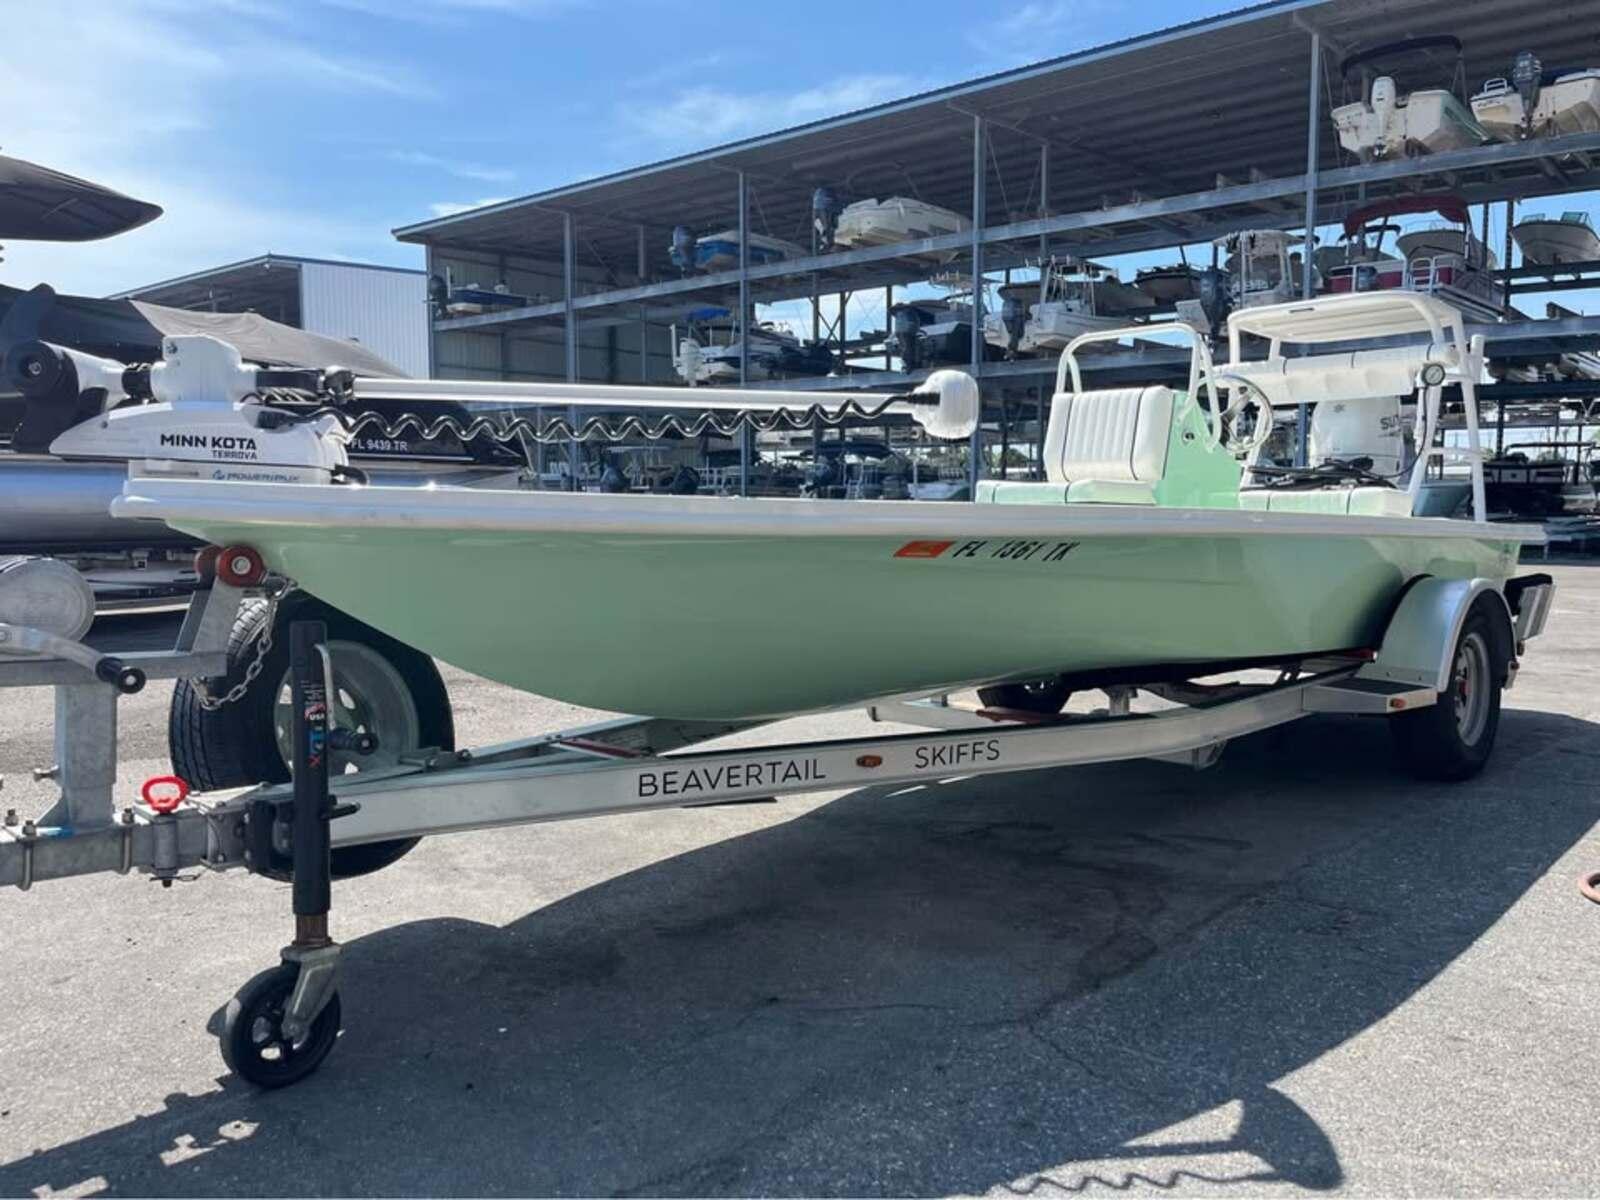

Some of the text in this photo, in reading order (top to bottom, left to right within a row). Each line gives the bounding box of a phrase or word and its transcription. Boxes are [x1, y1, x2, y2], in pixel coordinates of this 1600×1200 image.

[160, 433, 257, 450] MINN KOTA
[393, 440, 409, 452] TR
[952, 540, 989, 559] FL
[1040, 540, 1081, 562] TK
[638, 739, 1001, 798] BEAVERTAIL SKIFFS
